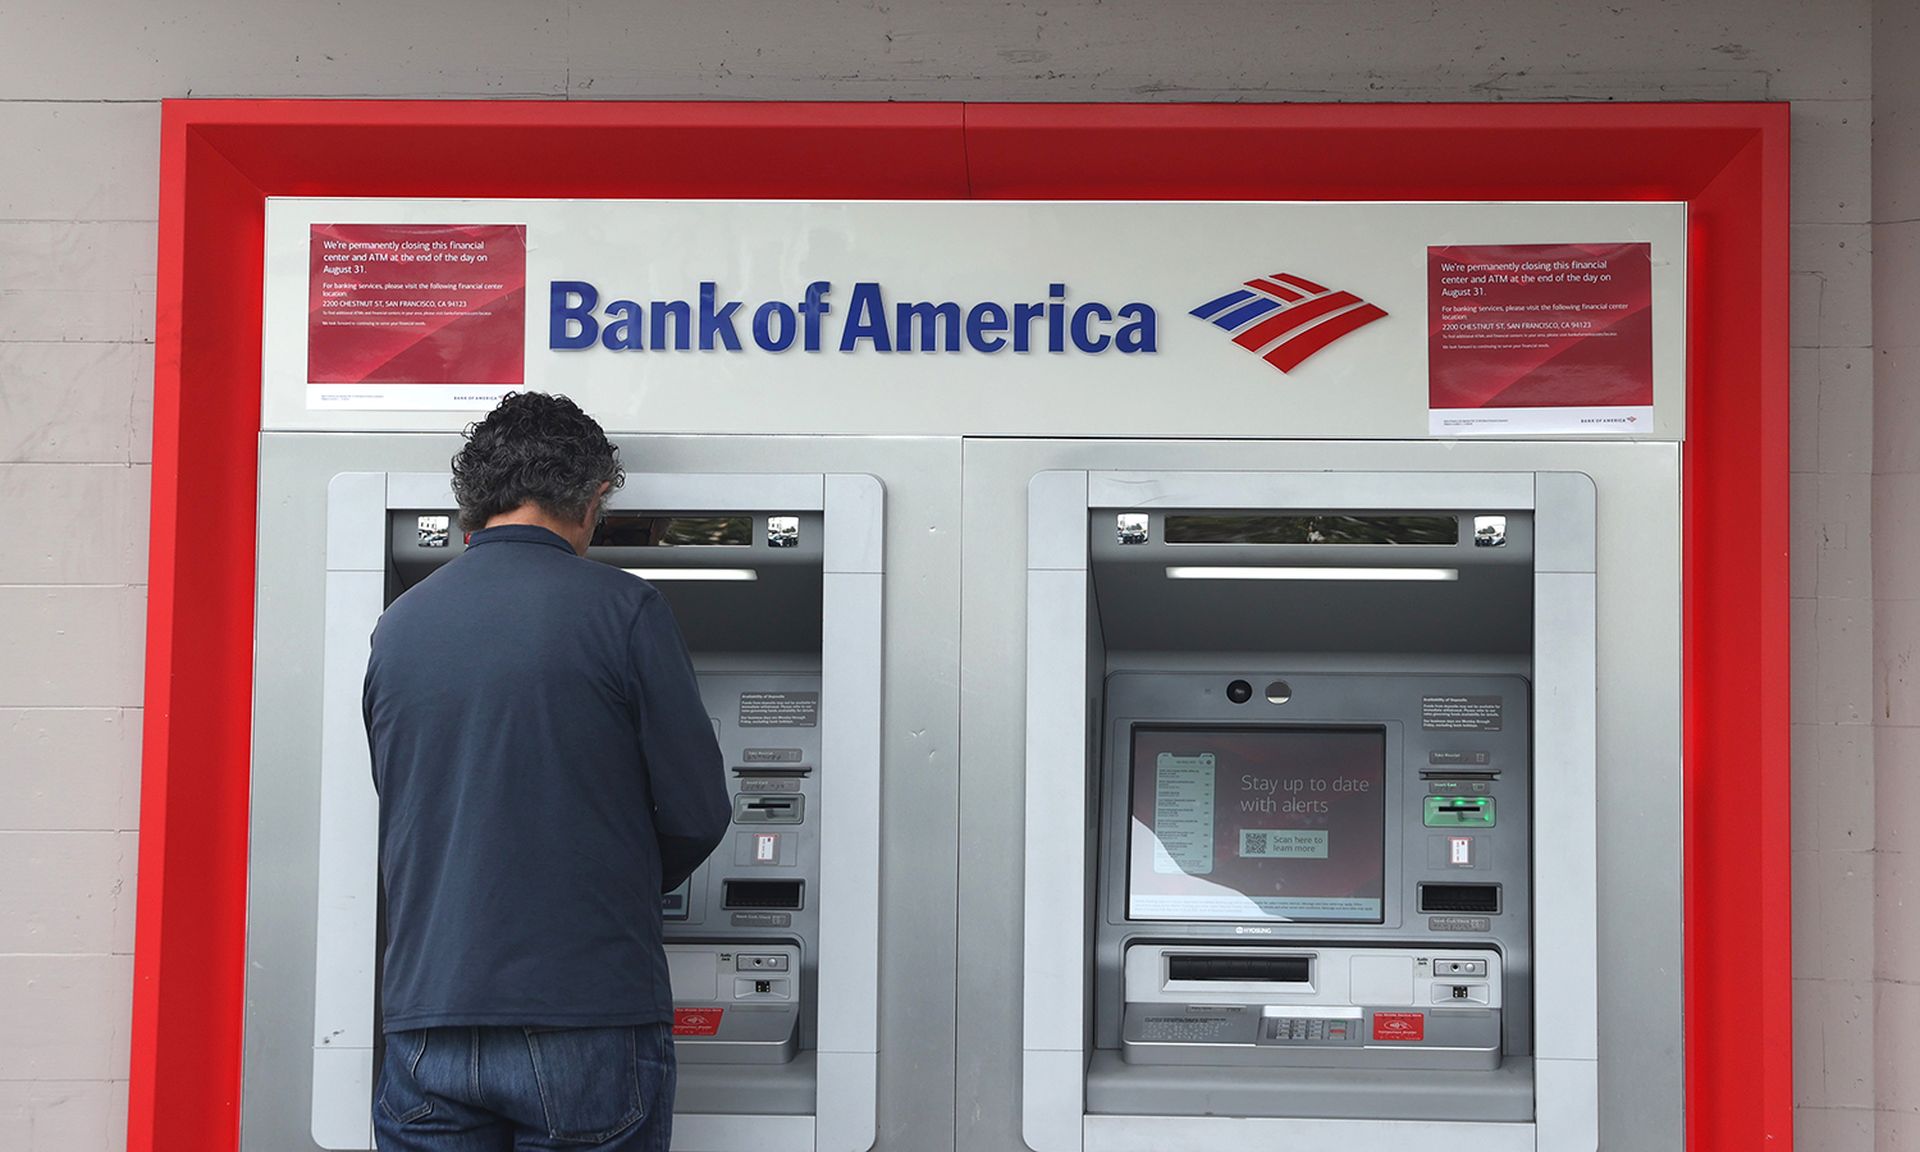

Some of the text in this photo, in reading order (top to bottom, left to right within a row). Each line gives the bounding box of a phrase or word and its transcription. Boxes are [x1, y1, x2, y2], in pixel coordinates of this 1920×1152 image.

[349, 243, 400, 251] permanently
[402, 242, 430, 252] closing
[450, 241, 484, 250] financial
[434, 254, 443, 262] of
[460, 254, 475, 264] day
[323, 265, 367, 275] August 31.
[1468, 264, 1520, 273] permanently
[1522, 262, 1552, 272] closing
[1554, 262, 1570, 270] this
[1572, 261, 1607, 269] financial
[1555, 274, 1564, 282] of
[1583, 274, 1598, 284] day
[1442, 288, 1486, 298] August 31.
[549, 280, 1158, 354] Bank of America
[1241, 775, 1369, 795] Stay up to date
[1241, 797, 1328, 813] with alerts
